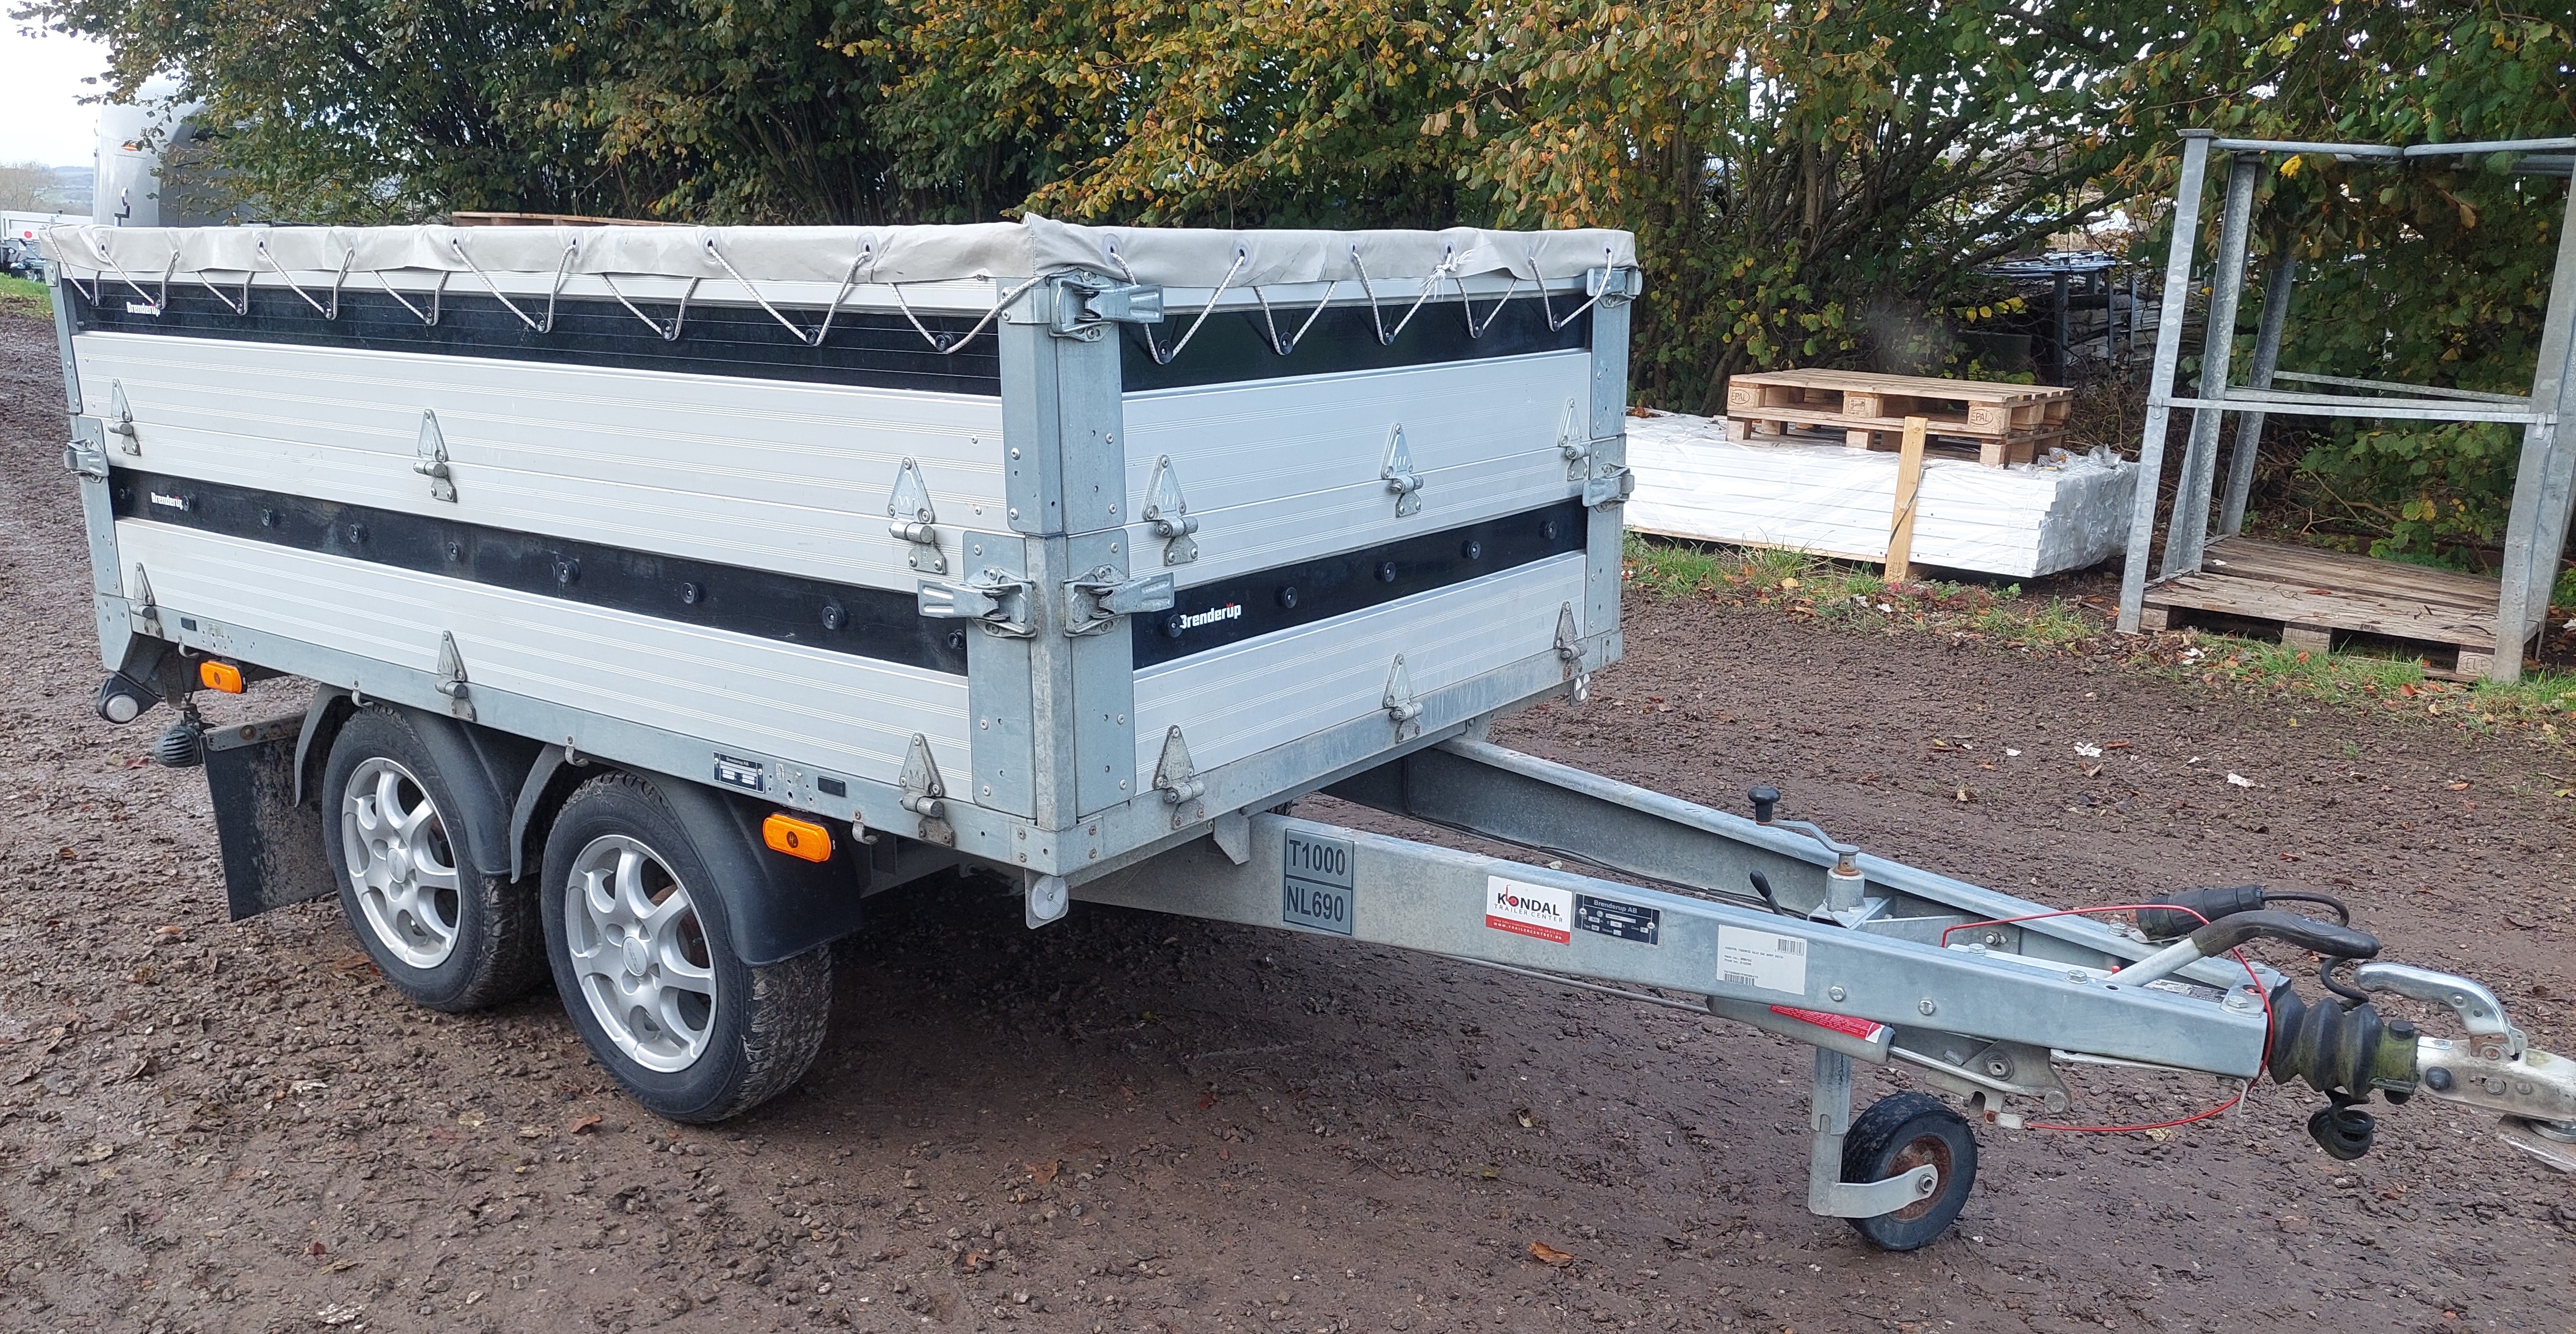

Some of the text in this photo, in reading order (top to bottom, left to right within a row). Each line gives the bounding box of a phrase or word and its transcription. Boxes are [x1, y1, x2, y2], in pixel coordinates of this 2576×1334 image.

[126, 301, 160, 317] Brenderup
[1731, 392, 1746, 401] EPAL
[1971, 412, 1989, 422] EPAL
[1179, 605, 1242, 629] Brenderup
[1289, 839, 1345, 875] T1000
[1287, 885, 1344, 922] NL690
[1494, 903, 1563, 923] TRAILER CENTER
[1497, 892, 1560, 916] KONDAL
